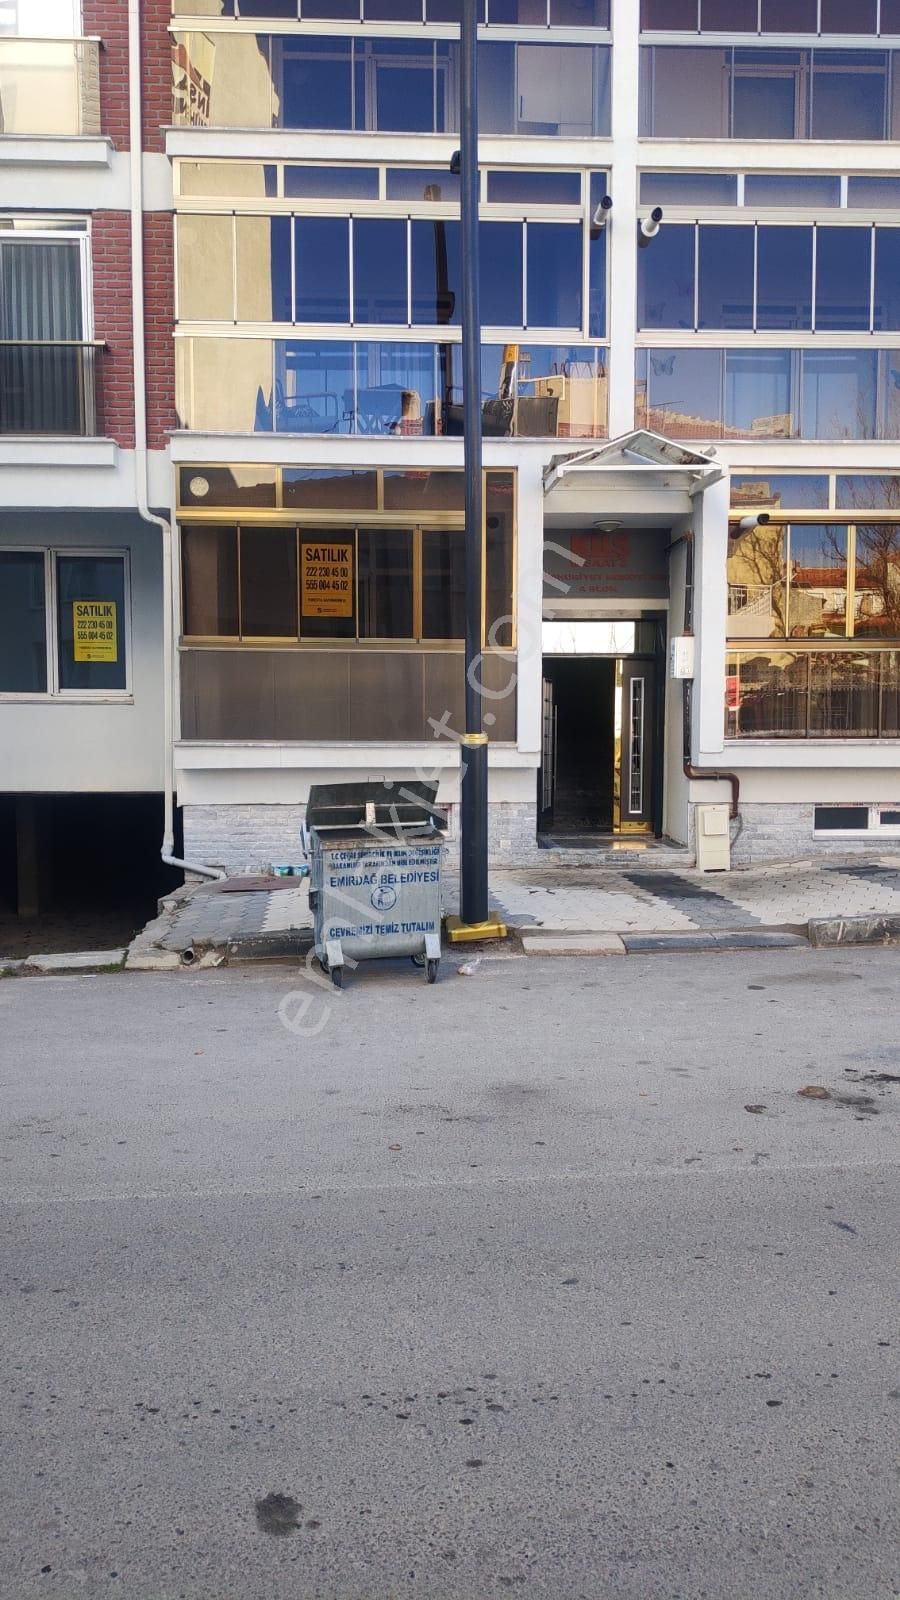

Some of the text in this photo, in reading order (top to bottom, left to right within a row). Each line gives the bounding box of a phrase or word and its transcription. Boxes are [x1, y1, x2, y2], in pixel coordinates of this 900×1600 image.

[306, 549, 348, 562] SATILIK
[306, 567, 317, 576] 222
[332, 567, 339, 577] 45
[340, 568, 348, 577] 00
[332, 581, 340, 590] 45
[341, 581, 348, 590] 02
[77, 605, 112, 616] SATILIK
[78, 620, 87, 628] 222
[99, 620, 106, 628] 45
[99, 632, 106, 640] 45
[106, 632, 112, 640] 02
[381, 870, 439, 884] BELEDİYESİ
[401, 921, 435, 933] TUTALIM
